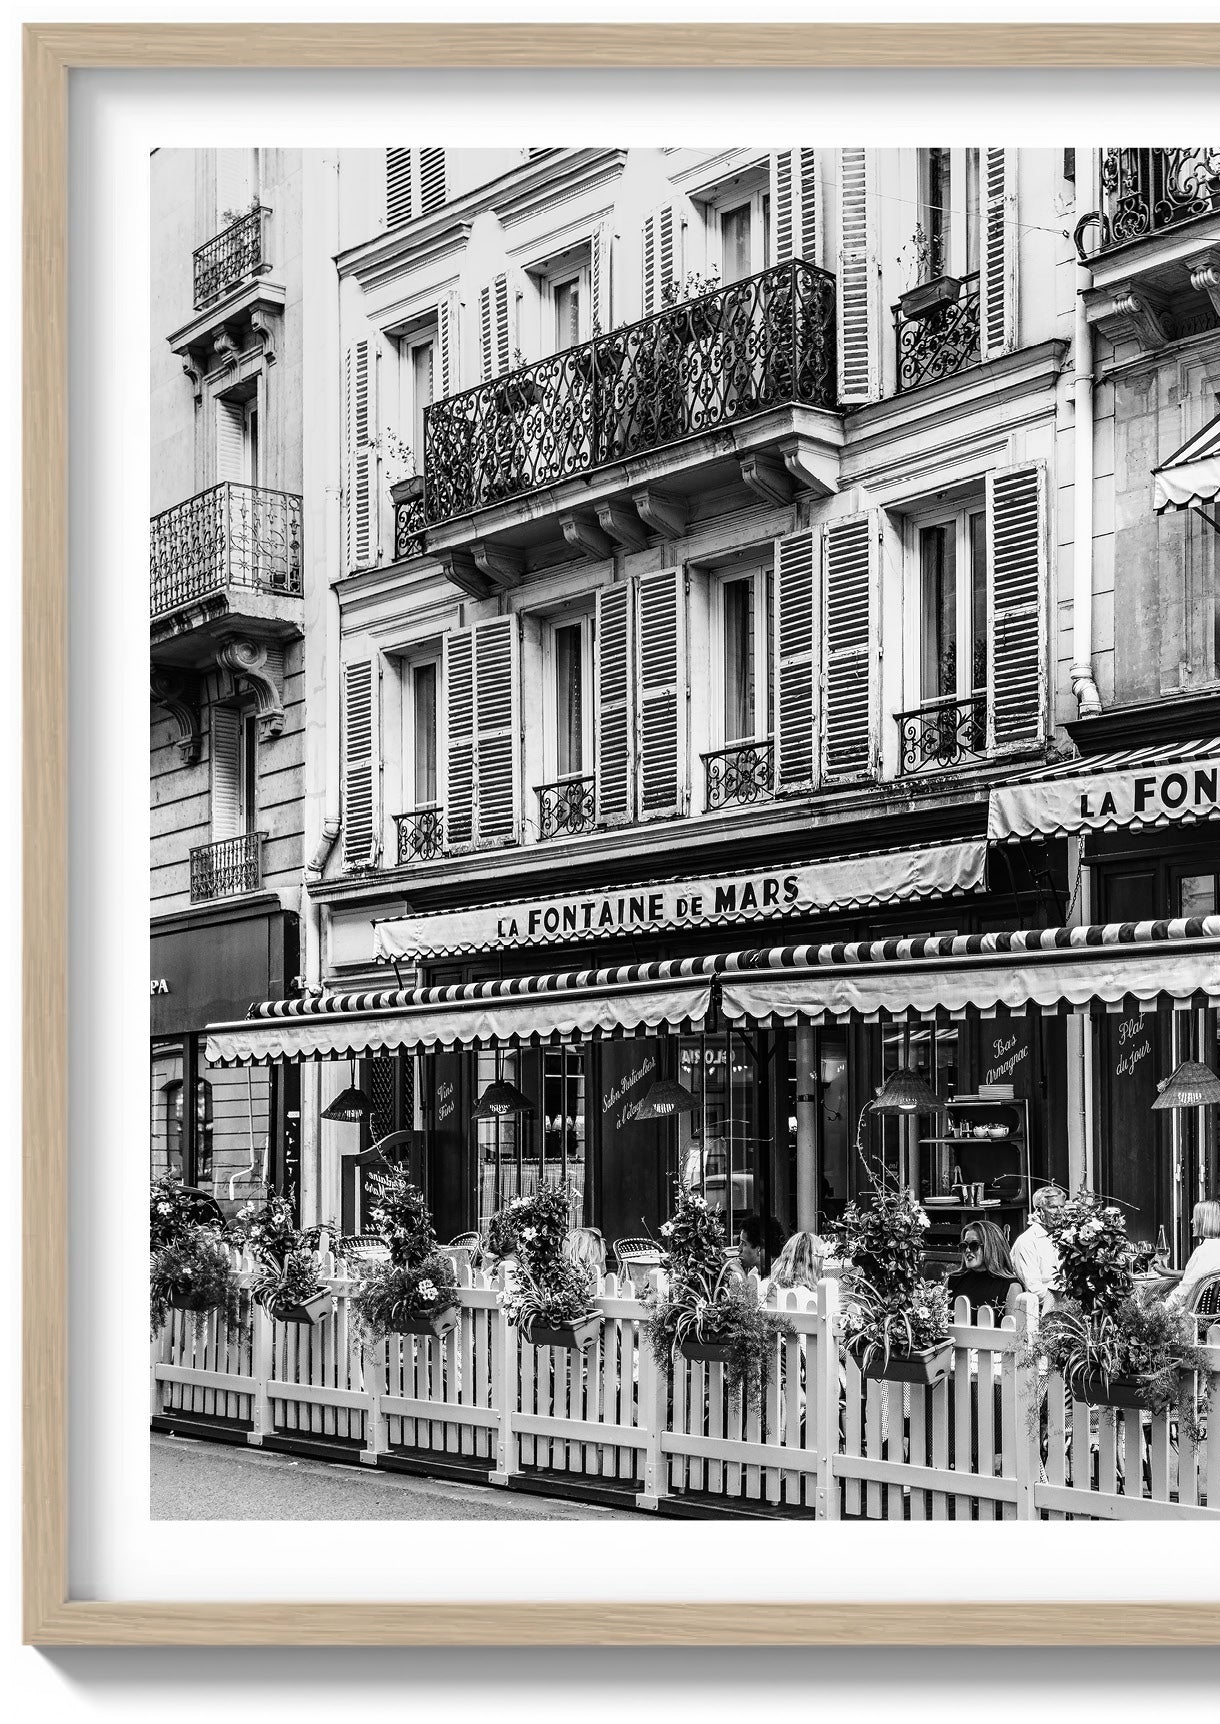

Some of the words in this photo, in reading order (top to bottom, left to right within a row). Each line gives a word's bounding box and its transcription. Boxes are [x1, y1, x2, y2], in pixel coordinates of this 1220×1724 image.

[1080, 791, 1118, 819] LA
[497, 919, 519, 938] LA
[528, 893, 664, 935] FONTAINE
[676, 898, 702, 918] DE
[715, 876, 800, 914] MARS
[1118, 1012, 1146, 1045] Plat
[993, 1034, 1018, 1058] Bas
[1116, 1054, 1129, 1075] du
[1128, 1040, 1152, 1075] jour
[437, 1082, 454, 1102] Vins
[602, 1087, 621, 1113] Salon
[438, 1100, 455, 1121] Fins
